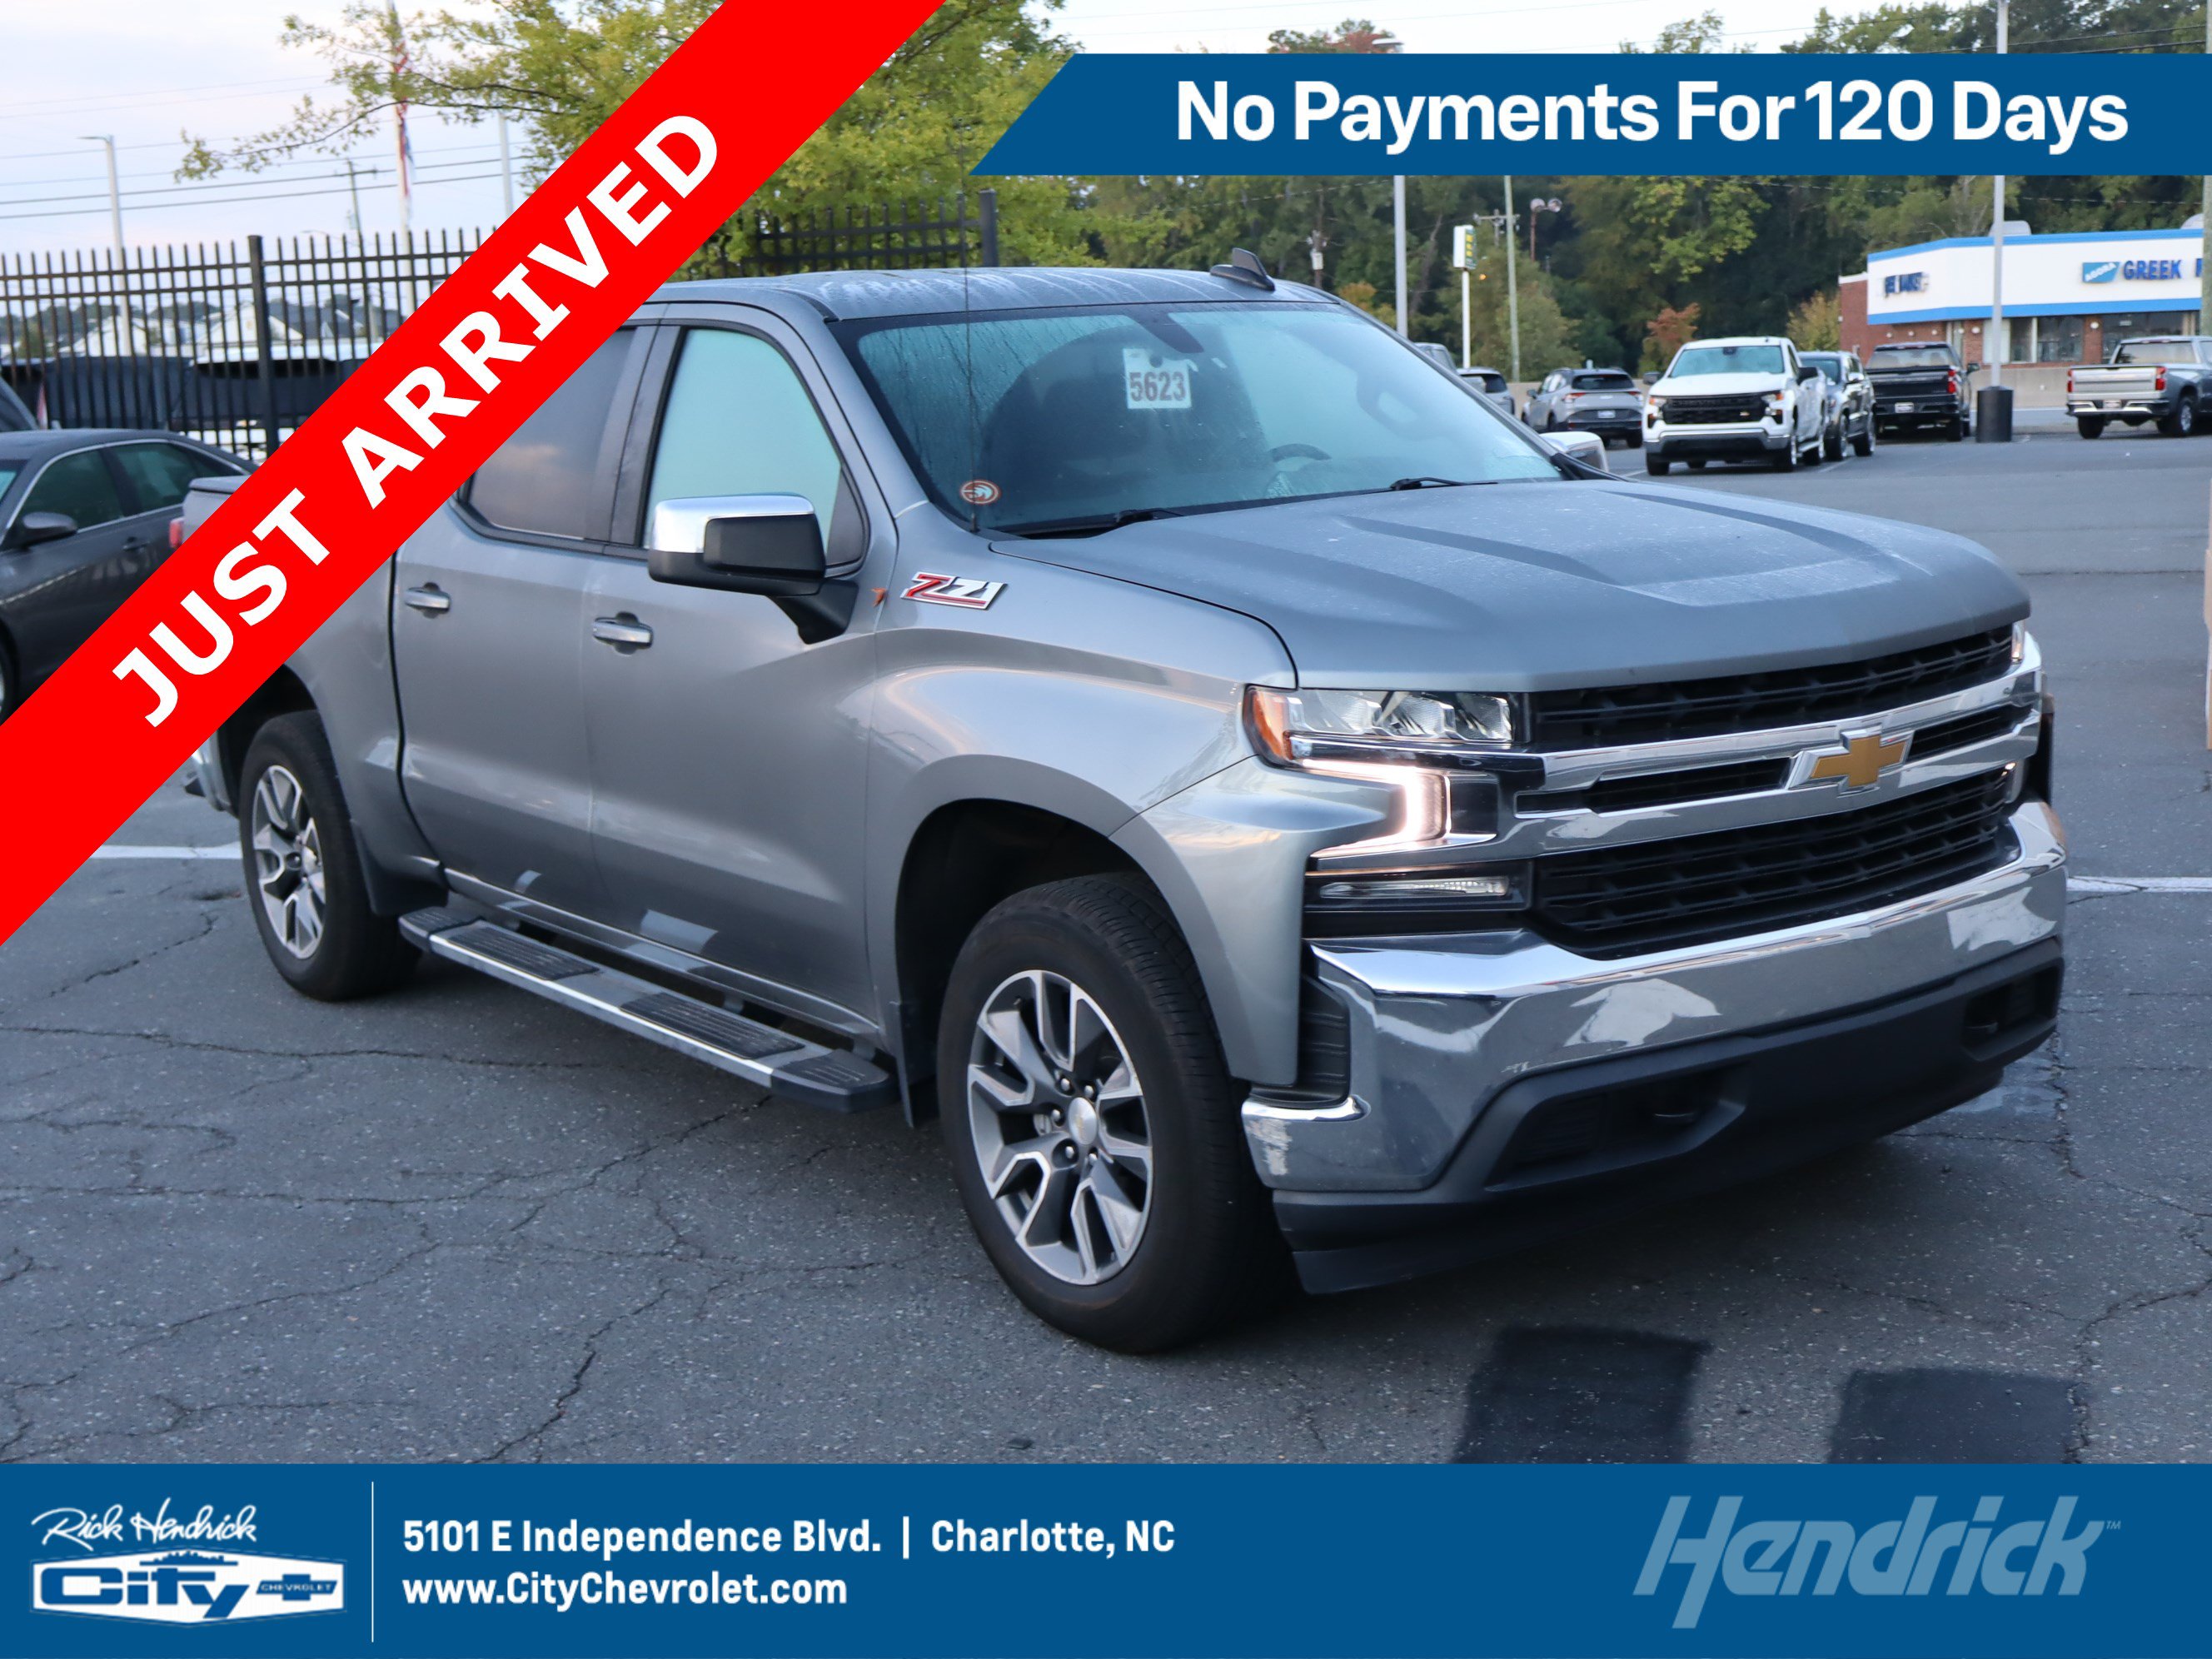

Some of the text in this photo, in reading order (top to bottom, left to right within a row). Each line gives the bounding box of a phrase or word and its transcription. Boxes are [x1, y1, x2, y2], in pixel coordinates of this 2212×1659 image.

[2123, 260, 2181, 280] GREEK
[1129, 371, 1186, 401] 5623
[899, 571, 1009, 610] Z71
